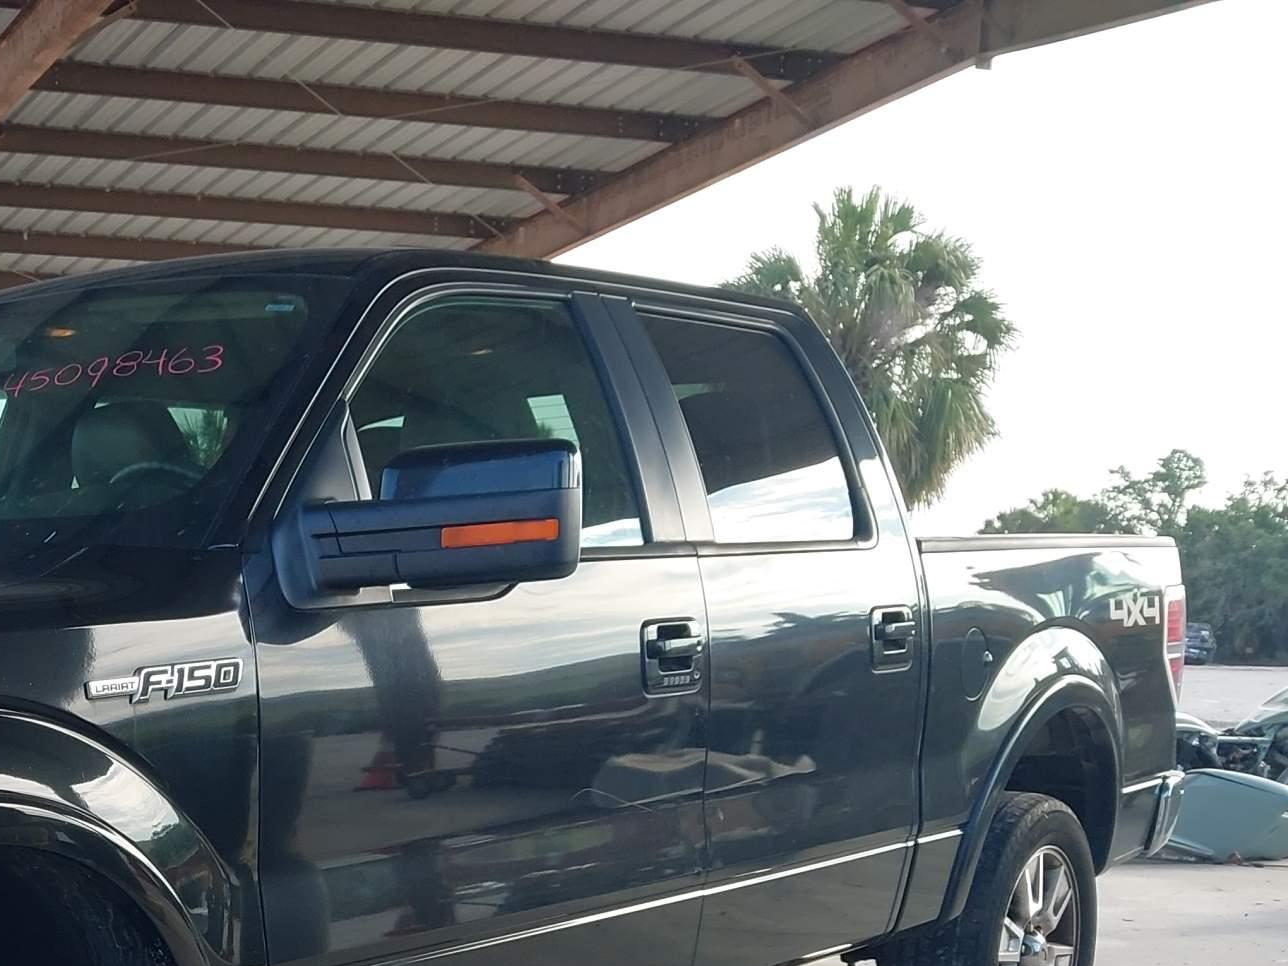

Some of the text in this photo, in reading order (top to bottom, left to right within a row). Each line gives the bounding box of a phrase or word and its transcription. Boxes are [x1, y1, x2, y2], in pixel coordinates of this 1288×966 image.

[3, 344, 225, 398] 45098463
[94, 658, 244, 705] LARIAT F-150
